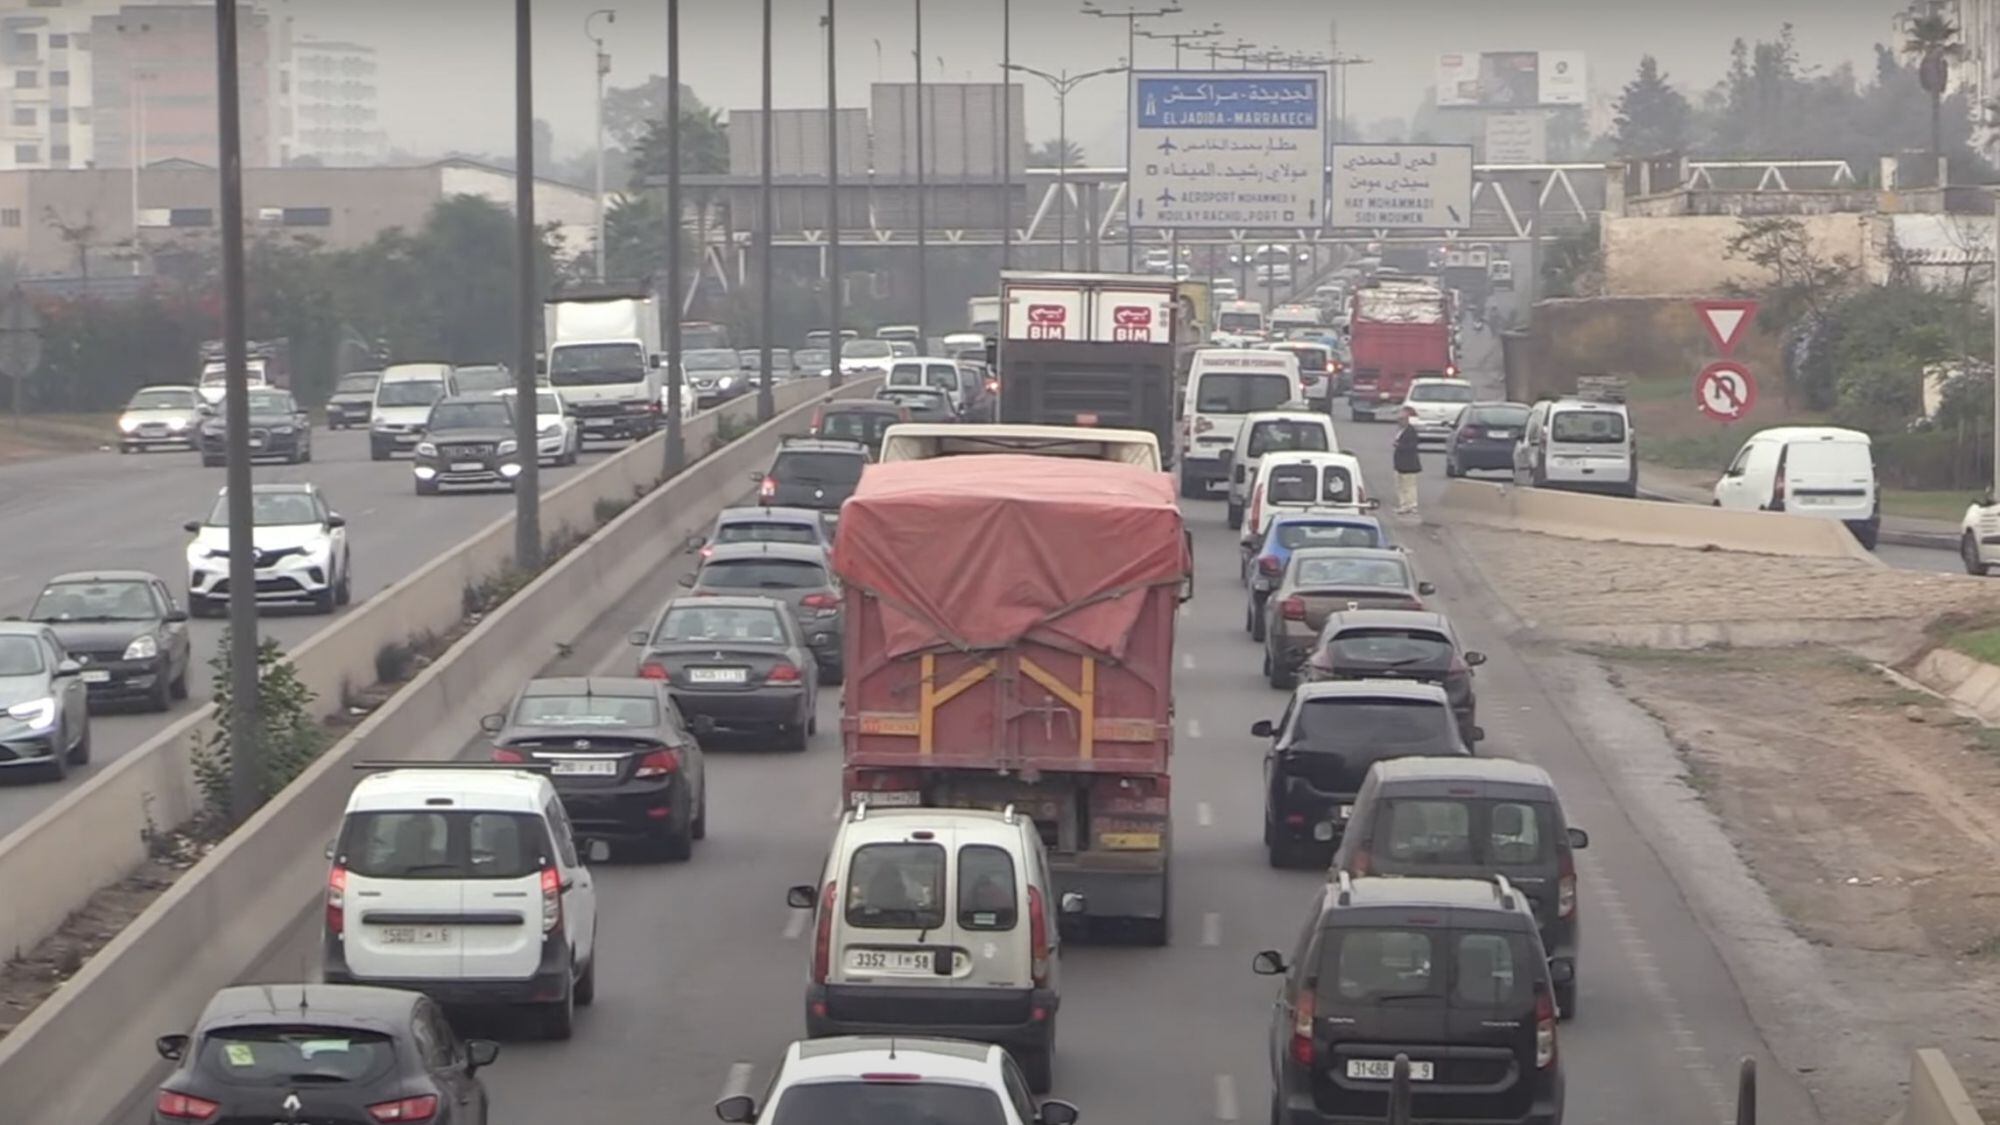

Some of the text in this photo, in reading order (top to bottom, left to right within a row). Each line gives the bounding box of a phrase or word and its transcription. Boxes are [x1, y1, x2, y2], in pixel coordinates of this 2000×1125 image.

[1163, 83, 1239, 107] مراكش
[1163, 111, 1178, 125] EL
[1180, 111, 1225, 125] JADIDA
[1234, 111, 1314, 125] MARRAKECH
[1181, 191, 1235, 203] AEROPORT
[1345, 197, 1363, 209] HAY
[1157, 210, 1200, 222] MOULAY
[1355, 211, 1376, 224] SIDI
[857, 953, 886, 968] 3352
